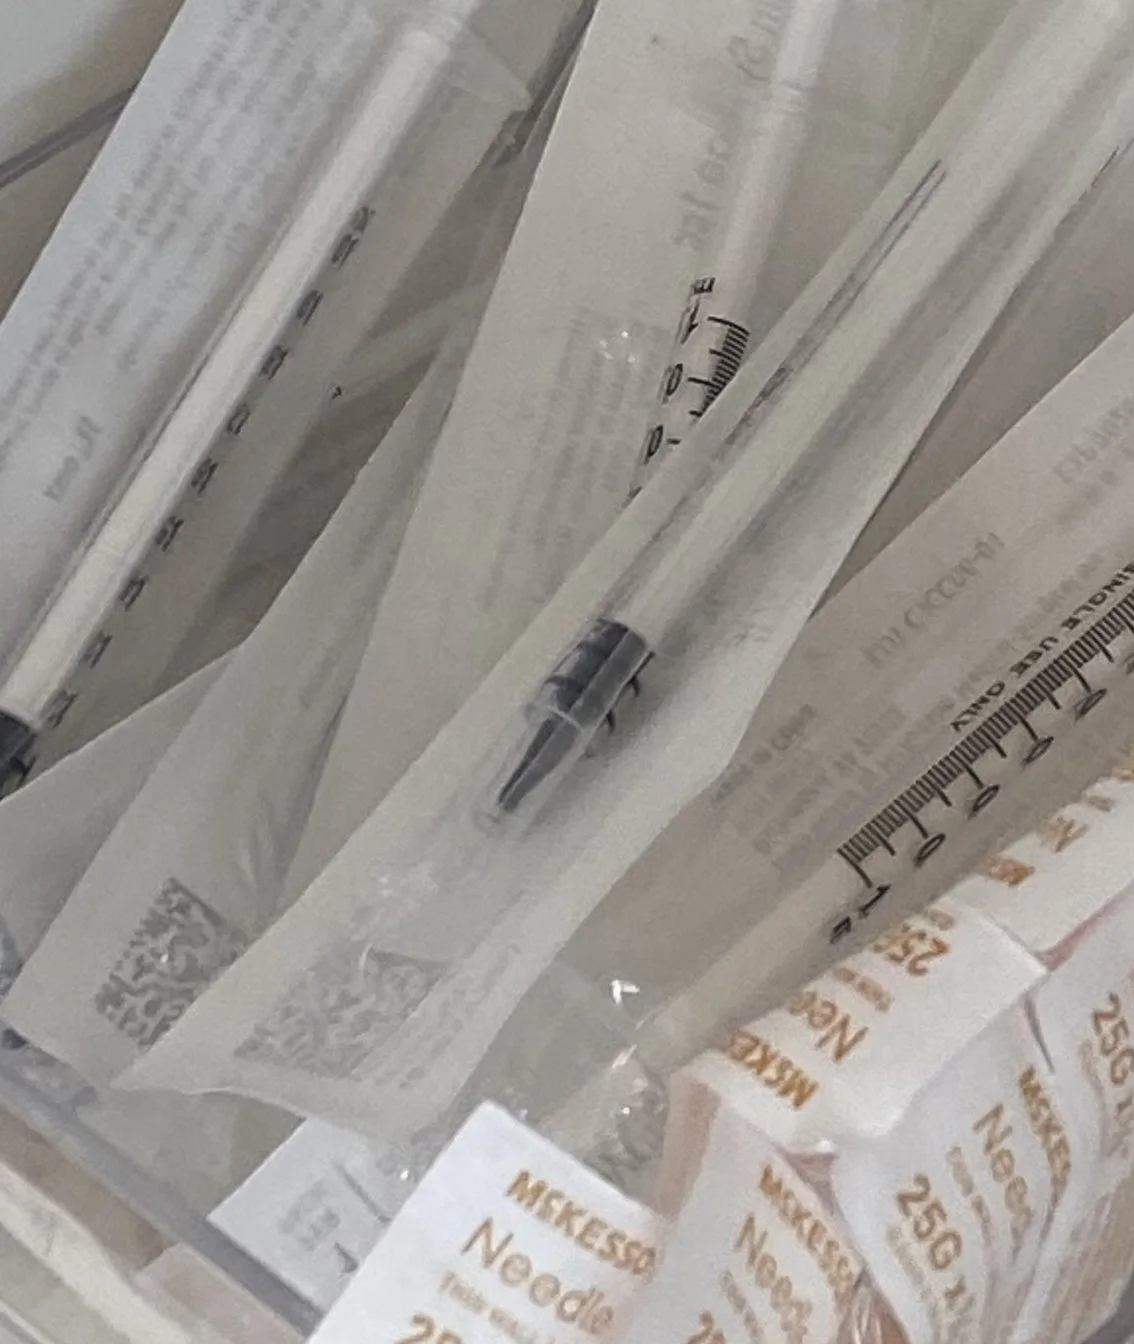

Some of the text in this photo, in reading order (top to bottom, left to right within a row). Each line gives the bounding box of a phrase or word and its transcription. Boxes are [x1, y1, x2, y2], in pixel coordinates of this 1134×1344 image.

[1009, 633, 1059, 679] USE
[949, 678, 1008, 732] ONLY
[890, 1171, 971, 1275] 25G
[459, 1213, 622, 1343] Needle
